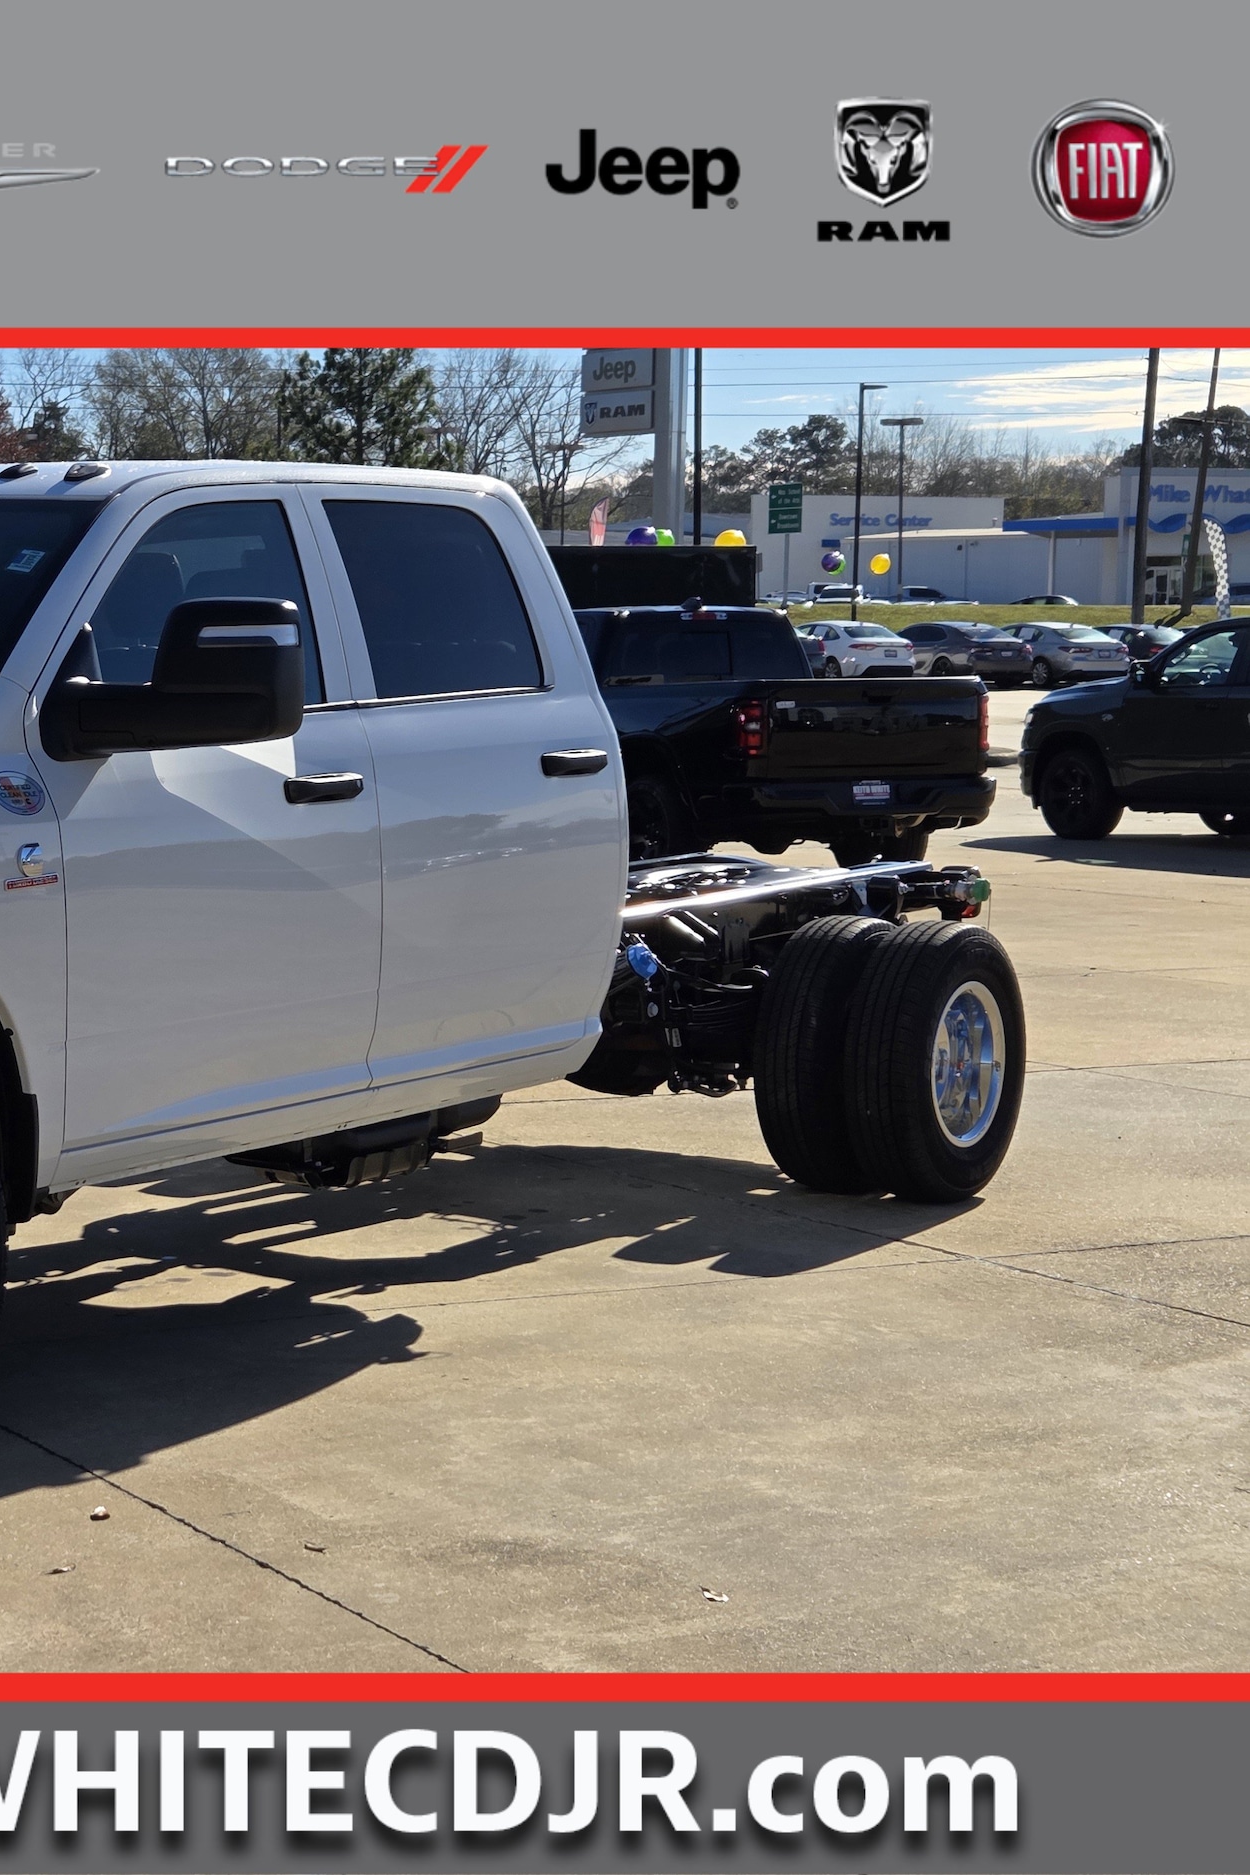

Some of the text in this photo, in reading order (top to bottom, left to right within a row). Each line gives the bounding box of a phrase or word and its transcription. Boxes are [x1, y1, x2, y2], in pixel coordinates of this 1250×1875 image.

[593, 356, 636, 383] Jeep
[599, 403, 645, 419] RAM
[1148, 484, 1191, 502] Mike
[830, 513, 881, 527] Serice
